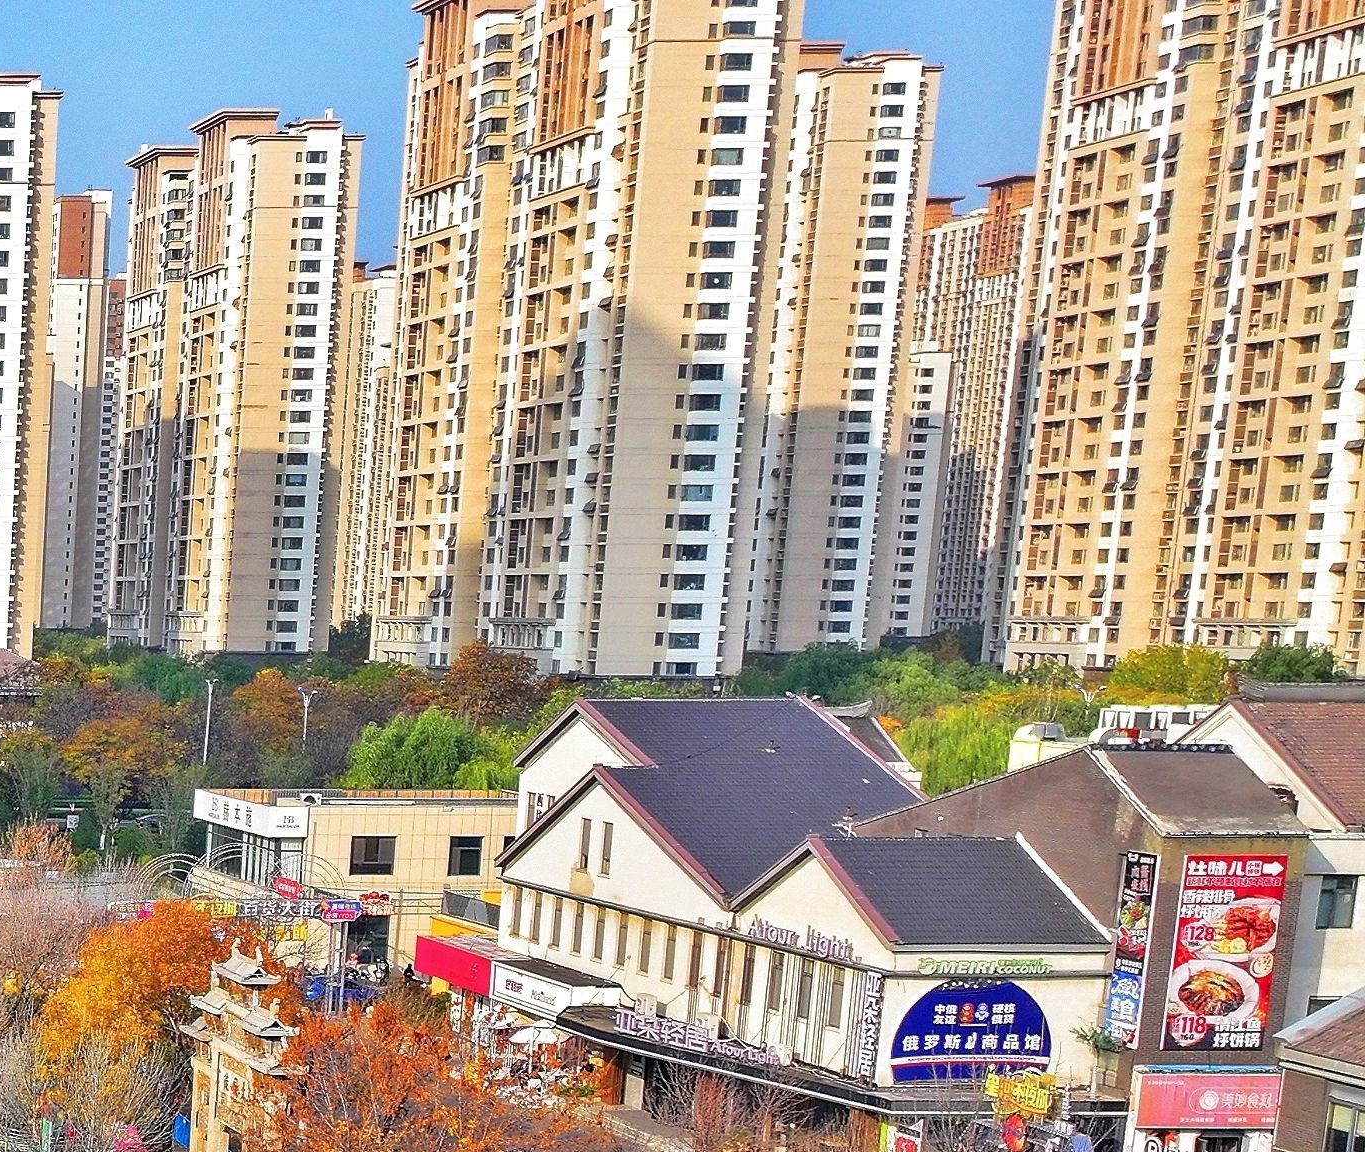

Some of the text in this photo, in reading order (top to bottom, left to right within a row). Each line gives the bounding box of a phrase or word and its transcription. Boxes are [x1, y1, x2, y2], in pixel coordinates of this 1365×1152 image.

[748, 914, 799, 948] Atour
[1189, 926, 1215, 941] 128
[937, 959, 996, 975] MEIRI
[996, 965, 1053, 975] COCONUT
[1181, 1016, 1207, 1034] 118
[902, 1033, 1042, 1052] 俄罗斯 商品馆
